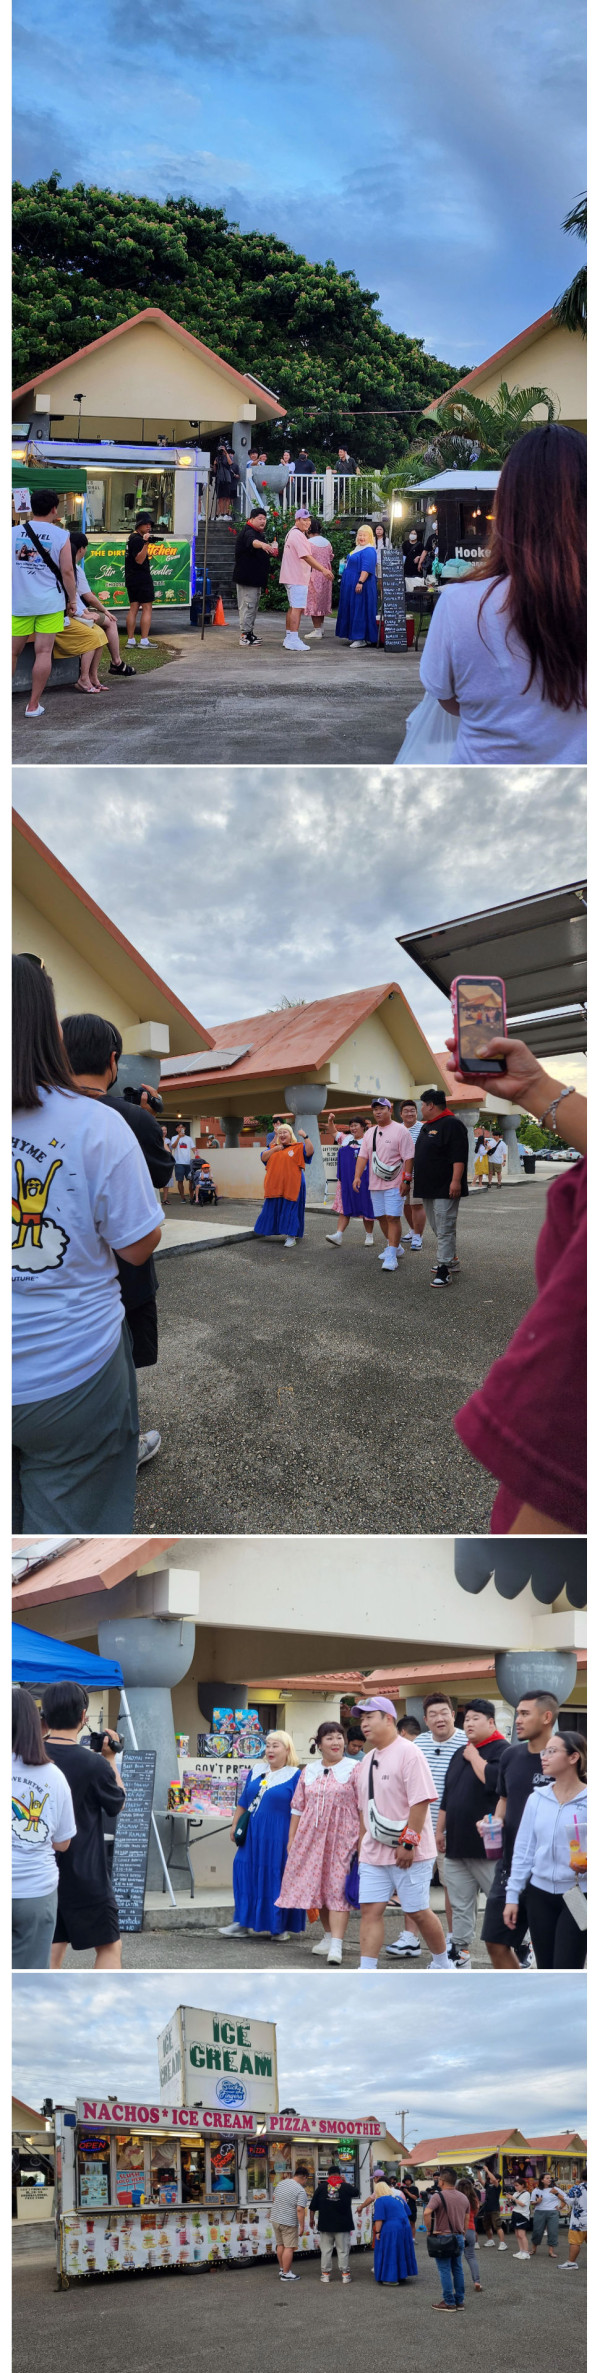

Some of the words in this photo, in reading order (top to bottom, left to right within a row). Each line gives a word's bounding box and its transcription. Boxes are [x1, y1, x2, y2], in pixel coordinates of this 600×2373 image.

[20, 532, 50, 540] TVEL
[150, 564, 173, 576] oodles
[196, 1763, 224, 1774] GOV'T
[213, 2017, 252, 2048] ICE
[162, 2028, 174, 2058] ICE
[190, 2041, 272, 2077] CREAM
[83, 2102, 160, 2124] NACHOS
[172, 2109, 198, 2126] ICE
[203, 2112, 254, 2130] CREAM
[270, 2116, 310, 2132] PIZZA
[318, 2121, 382, 2136] SMOOTHIE
[78, 2142, 106, 2150] OPEN
